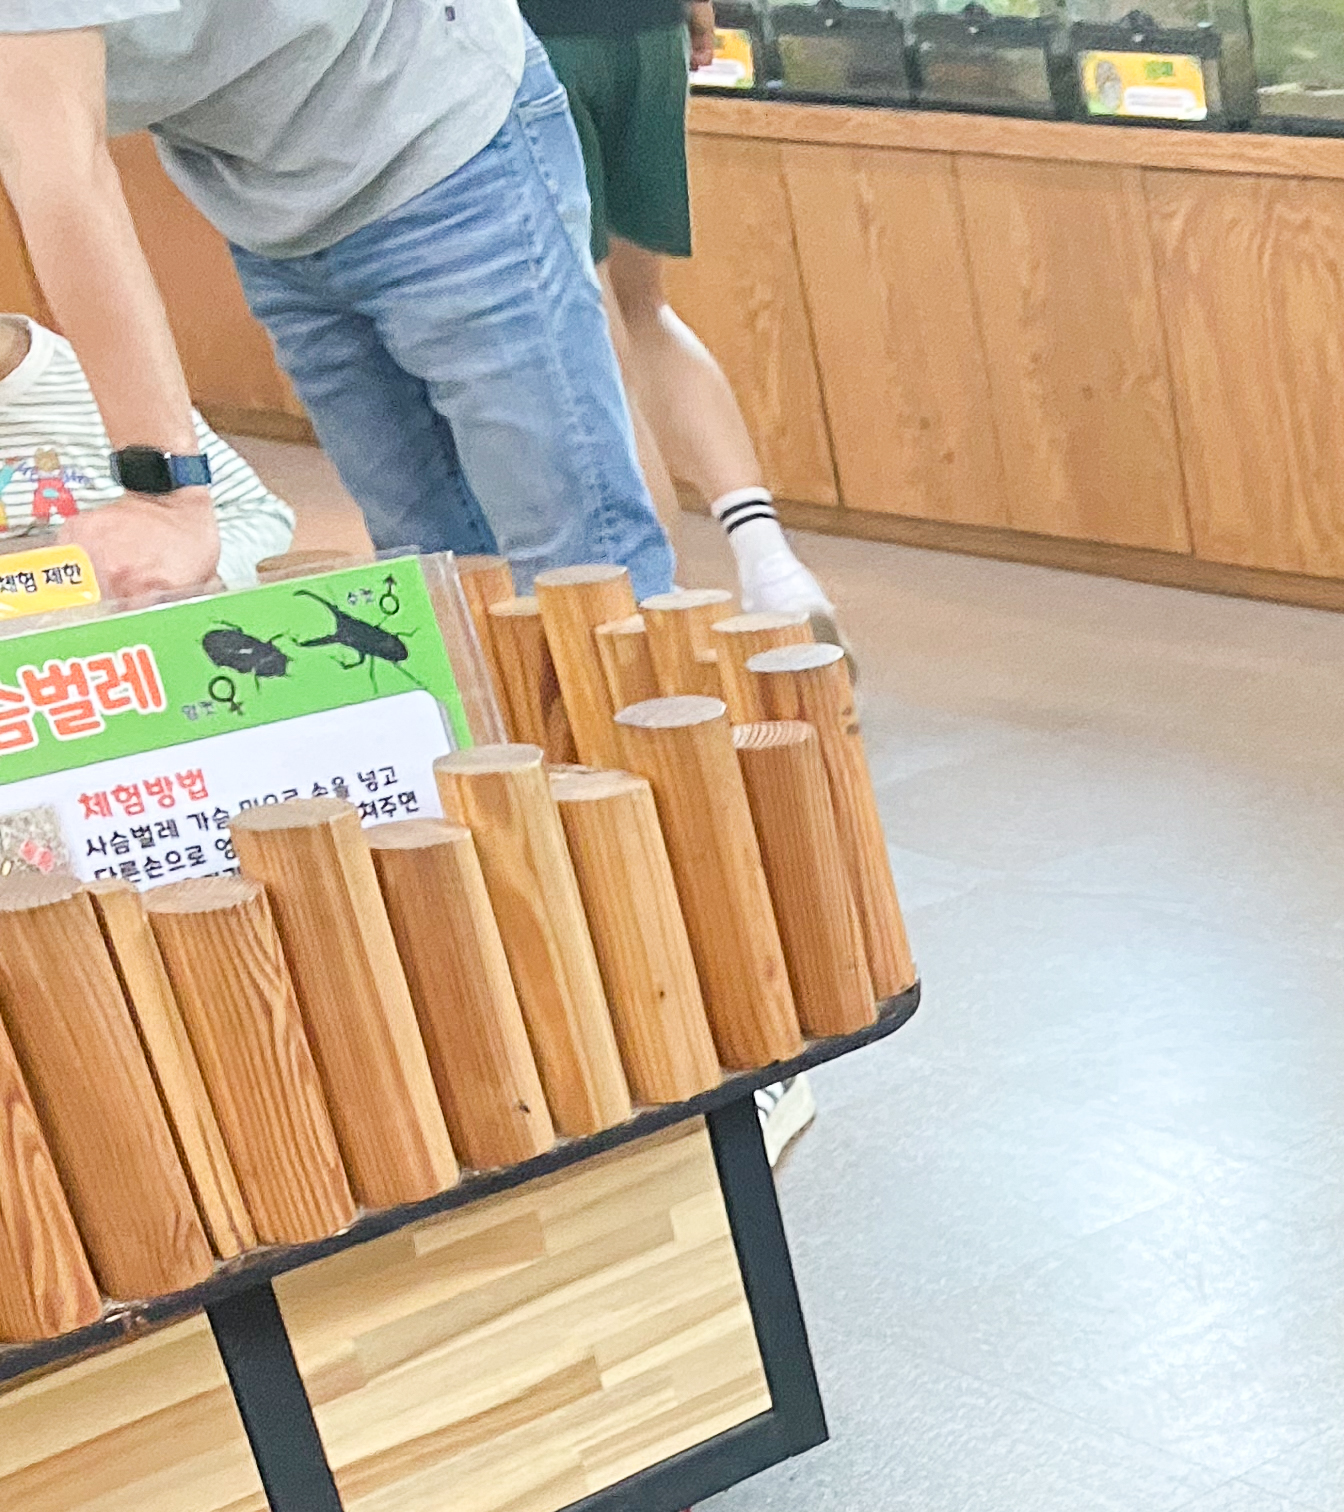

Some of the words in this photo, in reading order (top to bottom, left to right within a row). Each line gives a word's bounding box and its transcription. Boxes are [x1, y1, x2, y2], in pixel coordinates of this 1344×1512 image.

[42, 563, 82, 585] 제한
[77, 768, 209, 819] 체험방법
[86, 819, 179, 857] 사슴벌레
[187, 807, 231, 831] 가슴
[357, 766, 398, 792] 넣고
